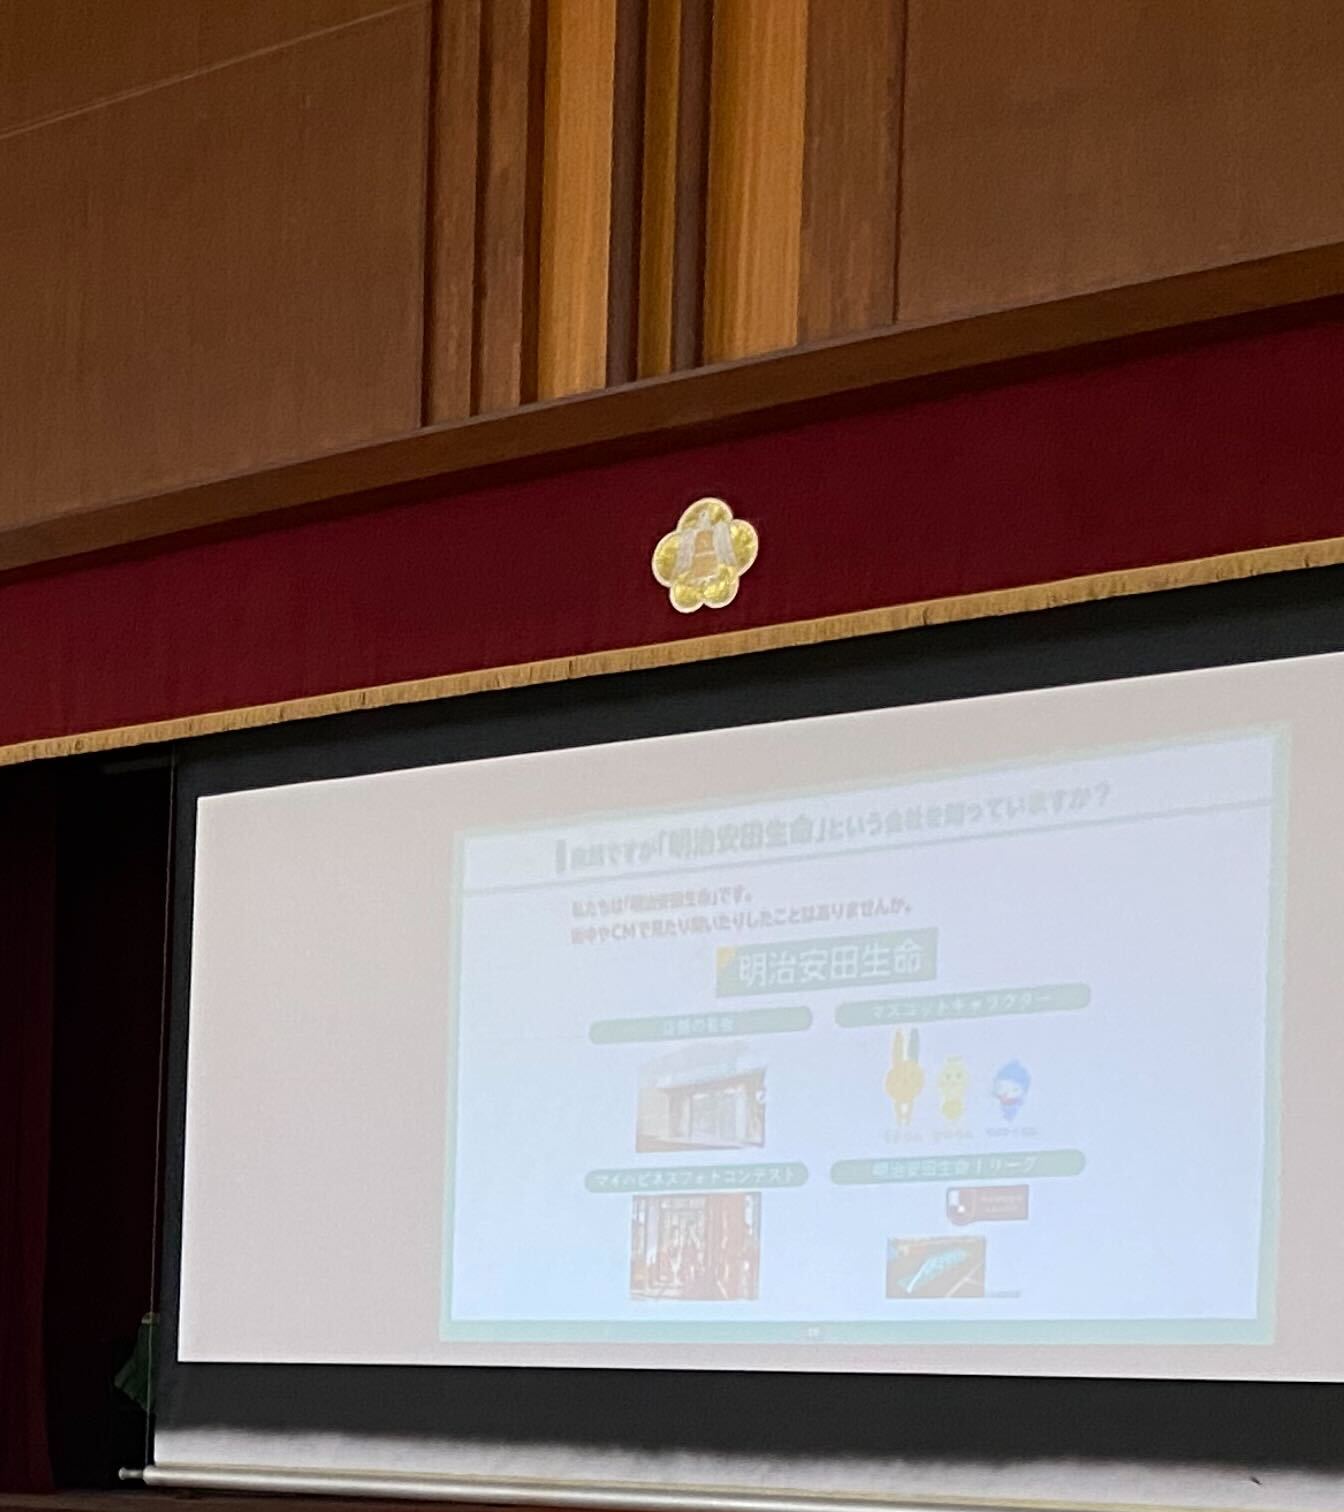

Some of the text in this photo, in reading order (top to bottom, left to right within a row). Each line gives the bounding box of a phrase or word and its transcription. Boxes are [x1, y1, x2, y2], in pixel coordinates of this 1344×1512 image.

[738, 937, 923, 987] 明治安田生命
